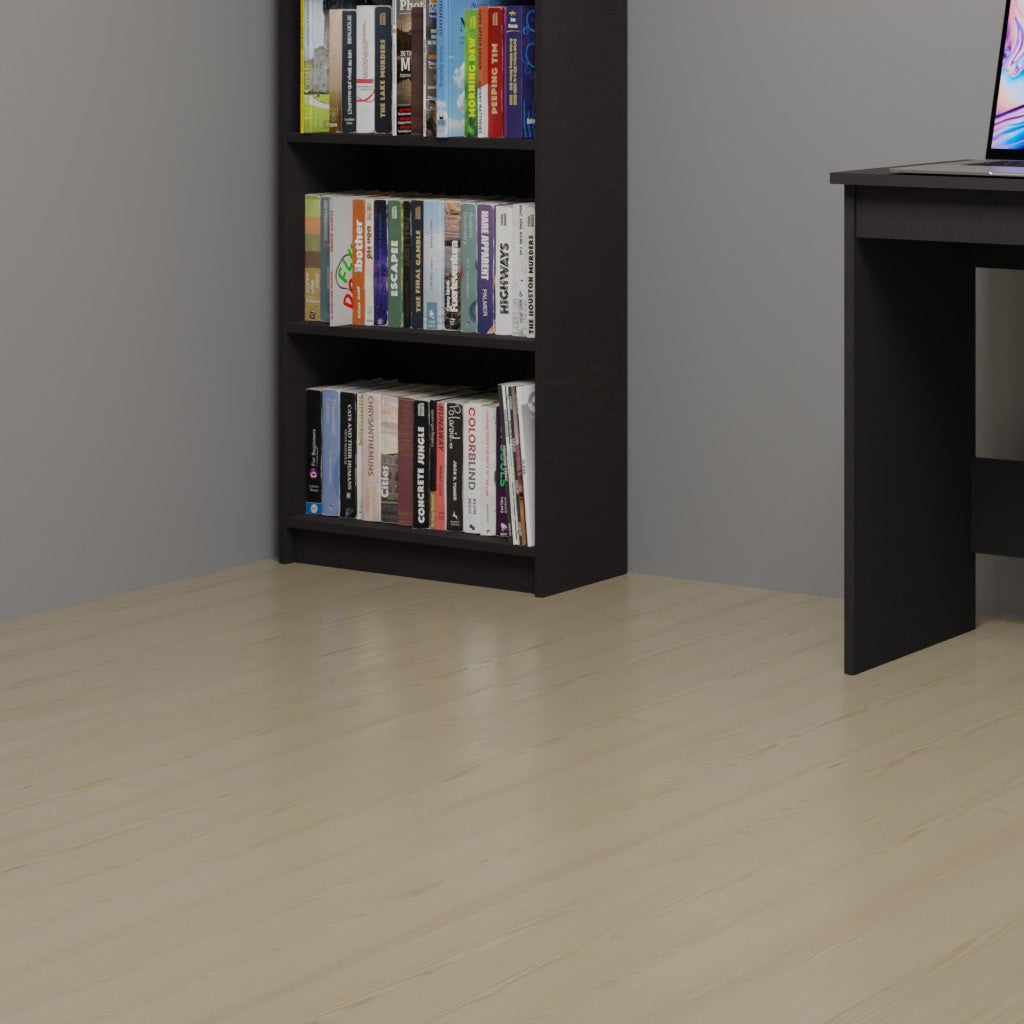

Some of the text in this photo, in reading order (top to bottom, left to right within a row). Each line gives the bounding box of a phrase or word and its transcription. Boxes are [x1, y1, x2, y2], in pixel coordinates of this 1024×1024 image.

[468, 37, 476, 118] MORNING DEW
[391, 240, 399, 297] ESCAPEE
[450, 240, 459, 313] Fuerteventura
[480, 235, 489, 281] APPARENT
[499, 242, 509, 315] HIGHWAYS
[367, 395, 375, 477] CHRYSANTHEMUMS
[468, 407, 476, 491] COLORBLIND
[381, 465, 389, 498] Cities
[416, 426, 425, 524] CONCRETE JUNGLE
